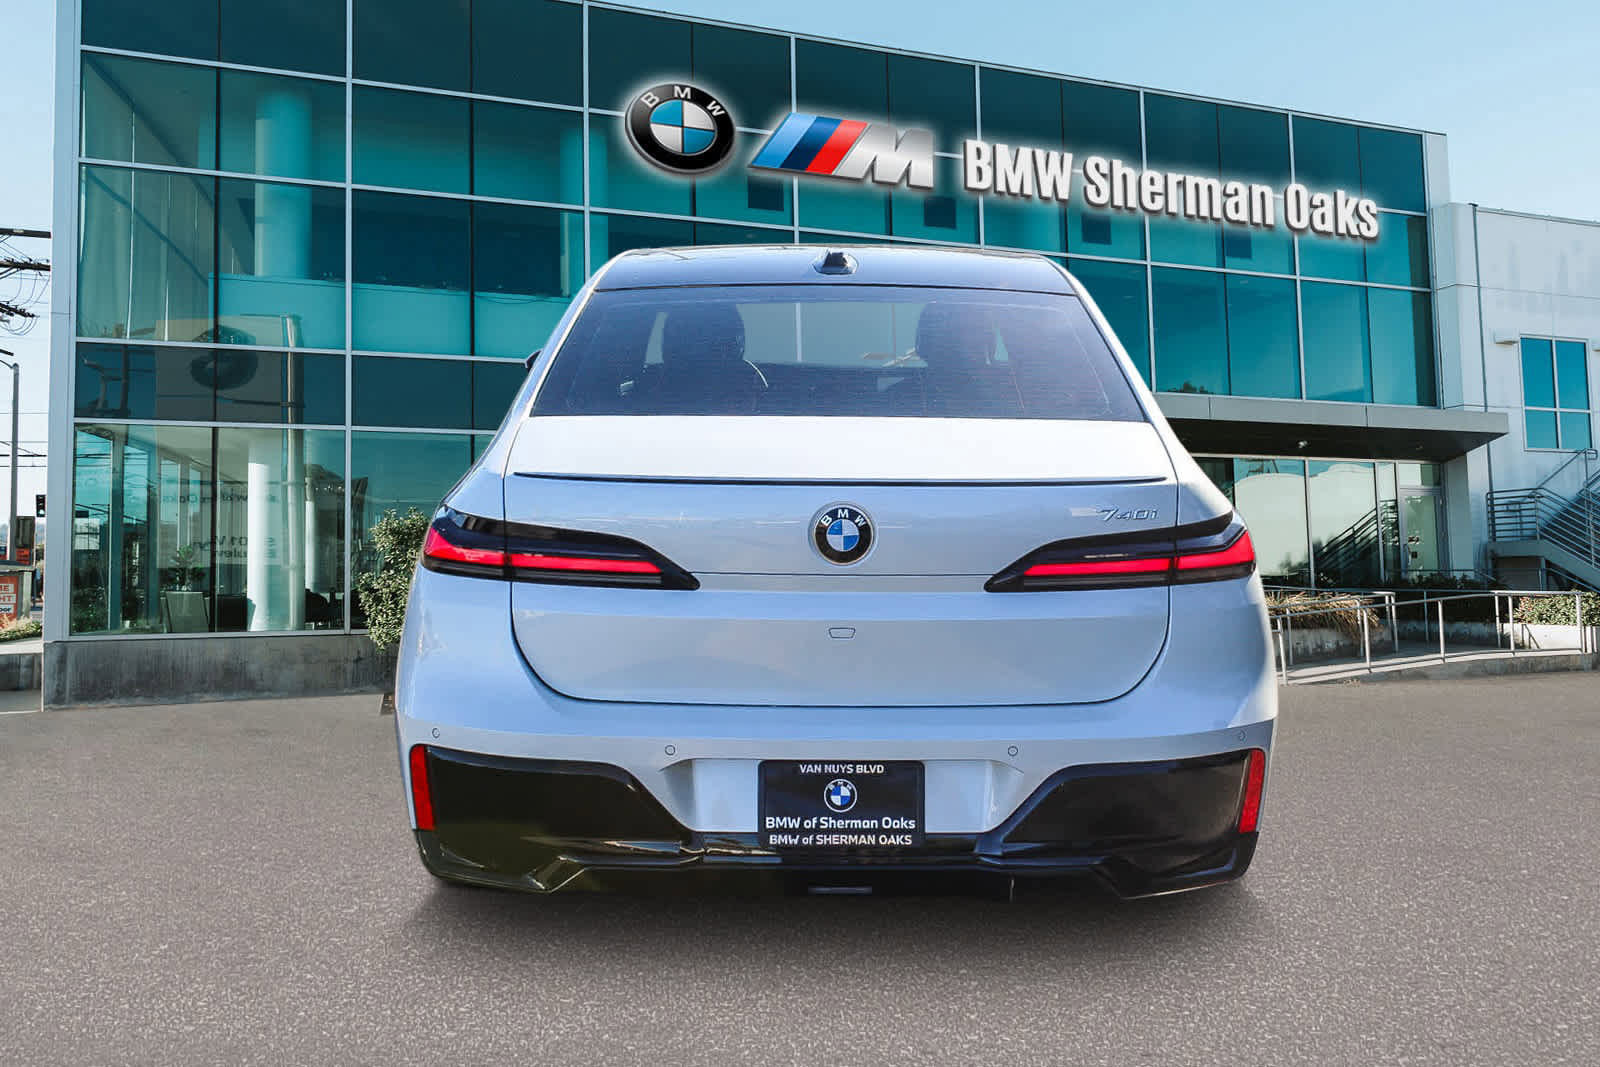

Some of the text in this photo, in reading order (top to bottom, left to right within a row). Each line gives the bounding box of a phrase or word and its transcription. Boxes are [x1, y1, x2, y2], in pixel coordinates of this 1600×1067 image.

[640, 85, 726, 117] BMW
[963, 139, 1379, 240] BMW Sherman Oaks
[821, 508, 867, 527] BMW
[799, 764, 885, 774] VAN NUYS BLVD
[765, 816, 916, 829] BMW of Sherman Oaks
[769, 834, 913, 845] BMW of SHERMAN OAKS
